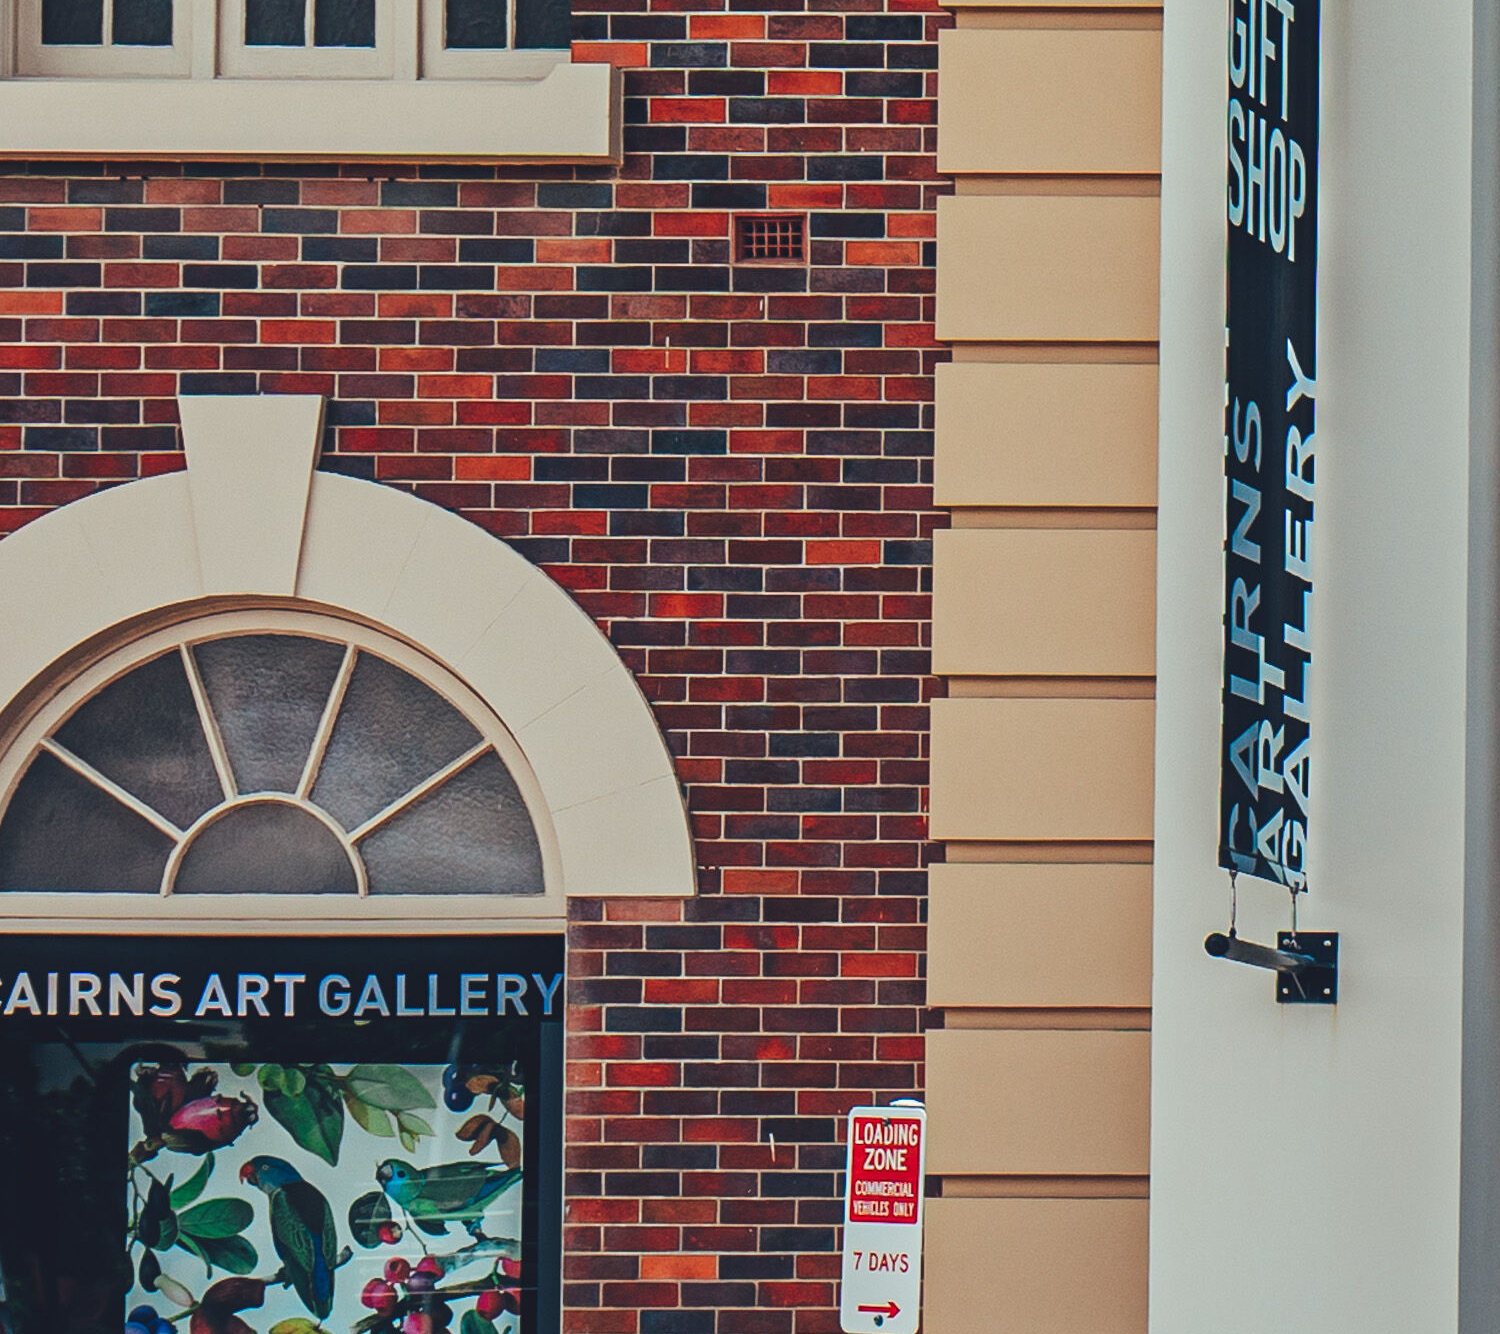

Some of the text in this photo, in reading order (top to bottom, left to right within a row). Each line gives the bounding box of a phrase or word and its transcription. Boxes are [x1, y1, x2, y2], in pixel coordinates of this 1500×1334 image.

[1229, 99, 1305, 262] SHOP
[1283, 338, 1316, 890] GALLERY
[1230, 395, 1263, 875] CAIRNS
[1257, 634, 1285, 886] ART
[0, 973, 564, 1017] AIRNS ART GALLERY
[855, 1123, 918, 1146] LOADING
[863, 1149, 907, 1171] ZONE
[855, 1180, 914, 1198] COMMERCIAL
[853, 1200, 914, 1217] VEHICLES ONLY
[853, 1251, 909, 1273] 7 DAYS
